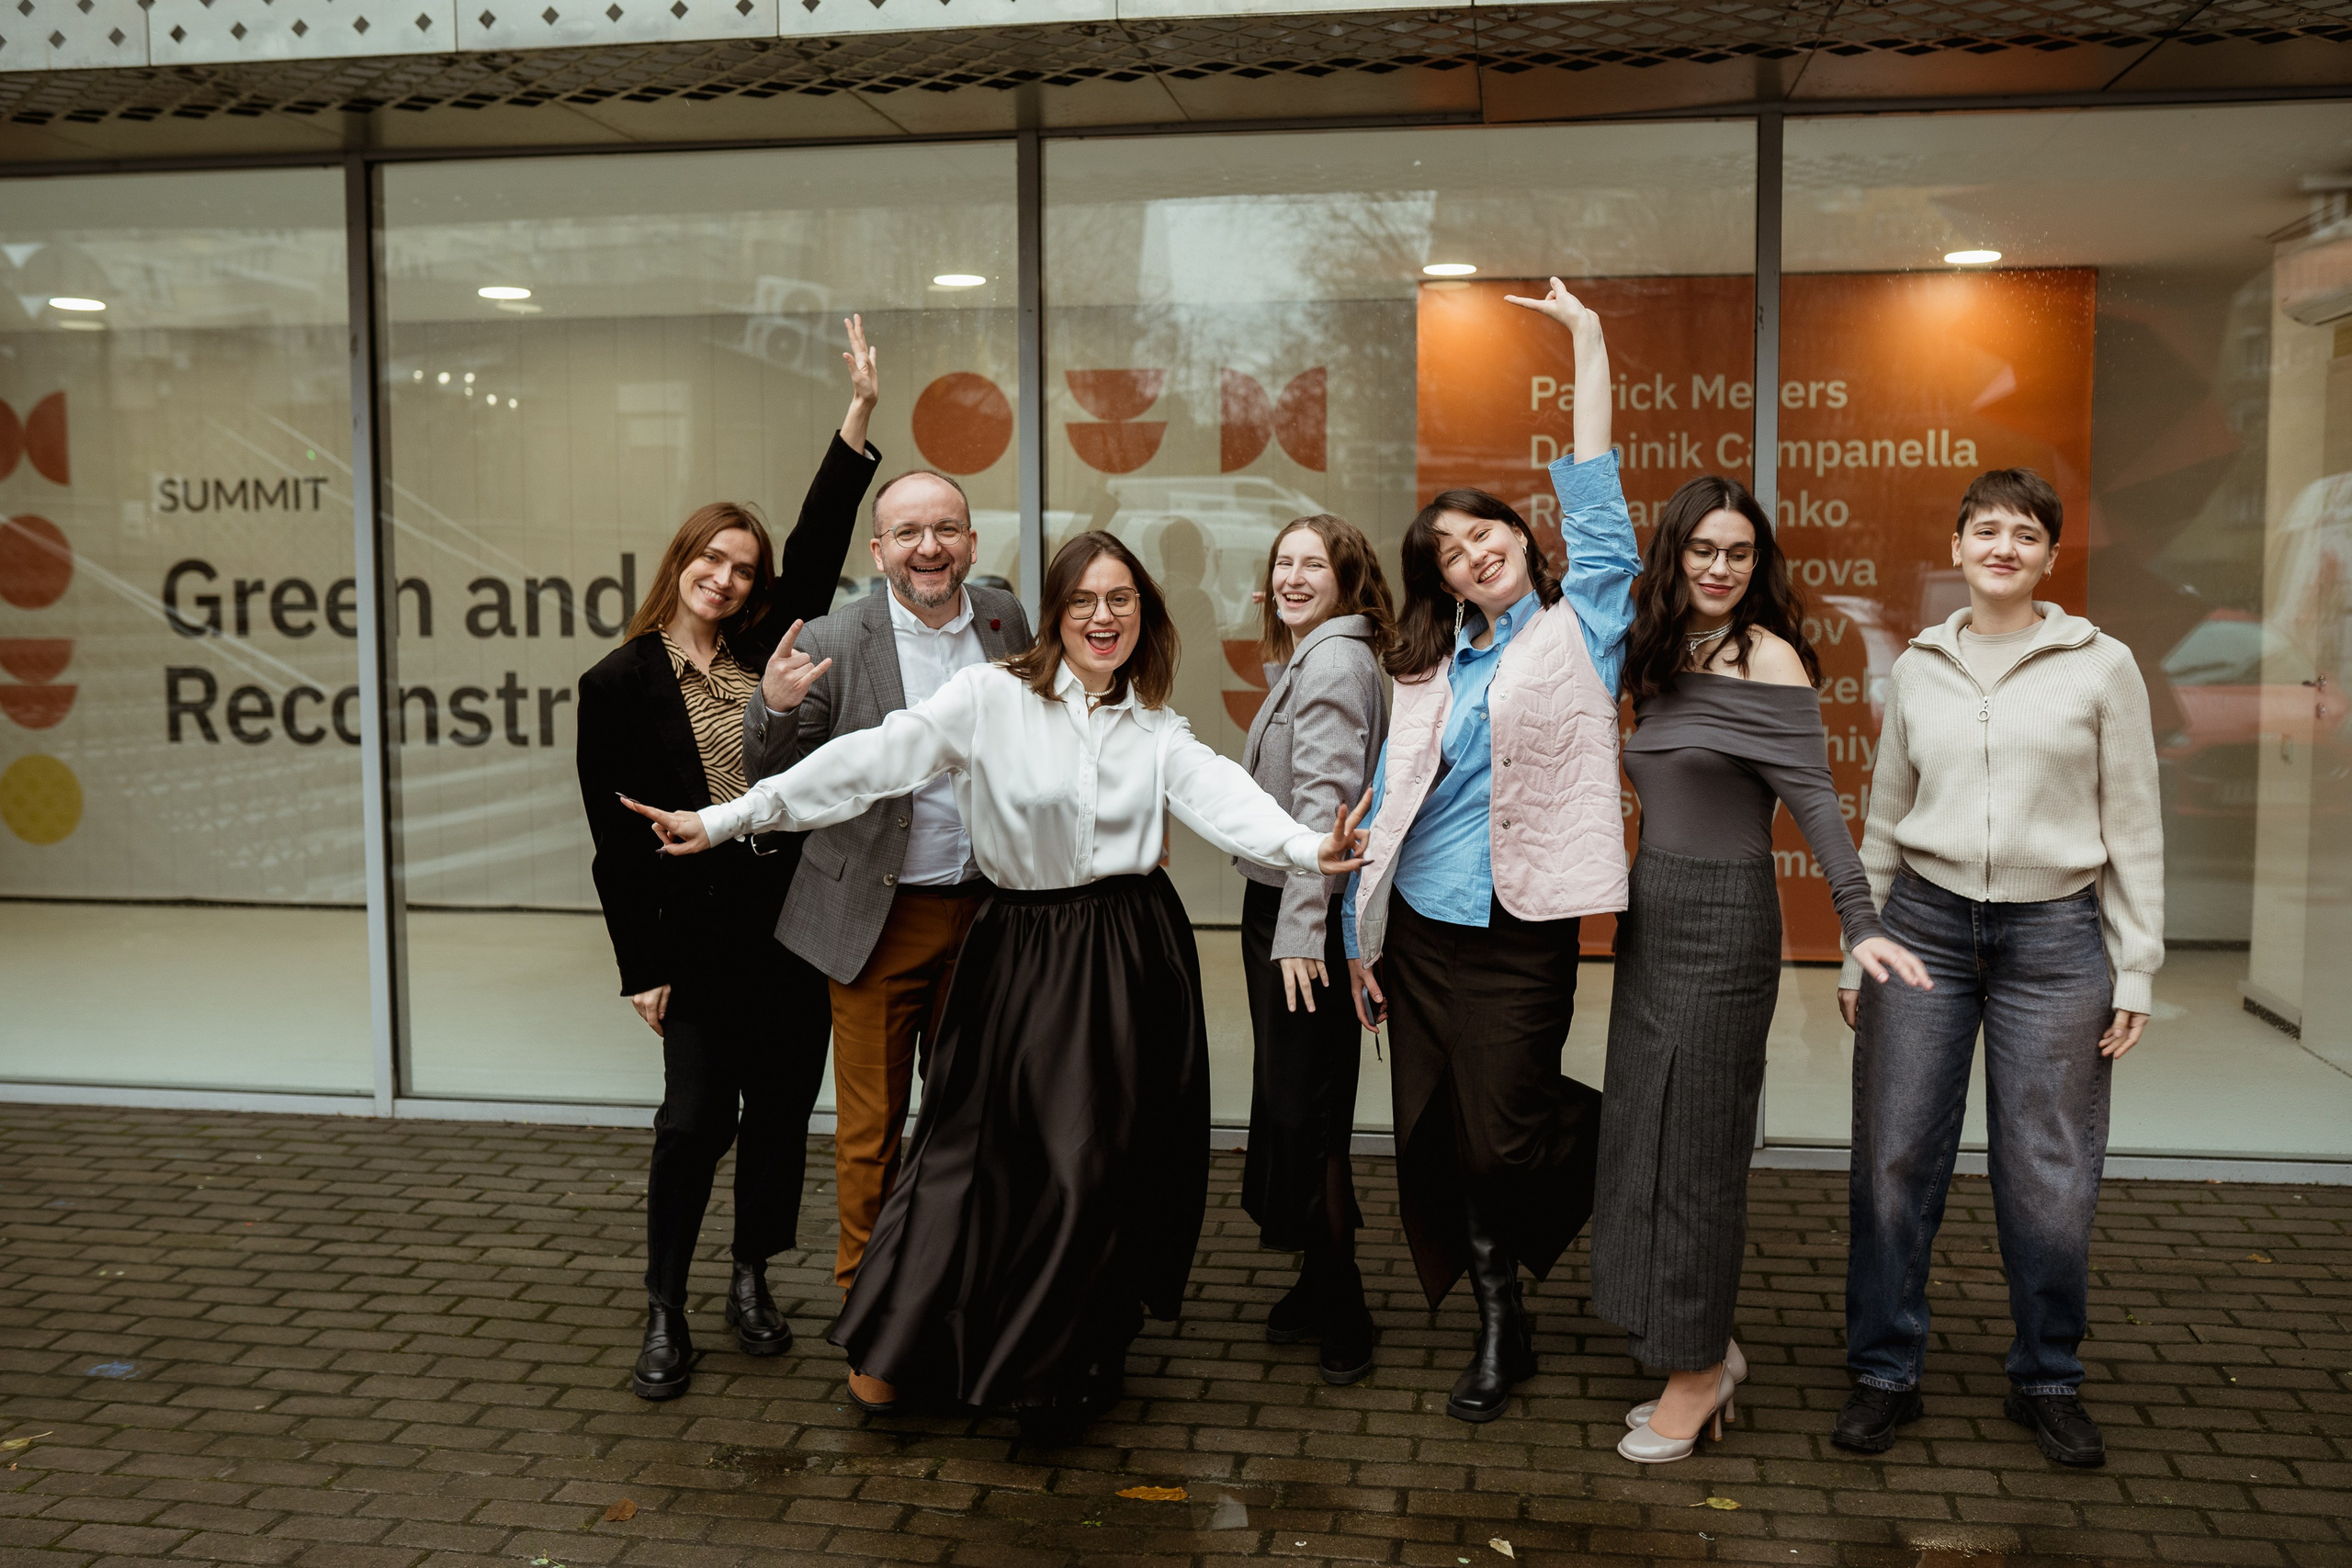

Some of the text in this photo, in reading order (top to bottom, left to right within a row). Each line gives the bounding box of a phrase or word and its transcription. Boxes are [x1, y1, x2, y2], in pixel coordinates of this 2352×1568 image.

[1530, 373, 1849, 412] Paick Meers
[1530, 429, 1979, 477] Dinik Cmpanella
[159, 478, 328, 513] SUMMIT
[163, 553, 636, 639] Green and
[164, 666, 571, 748] Reconstr
